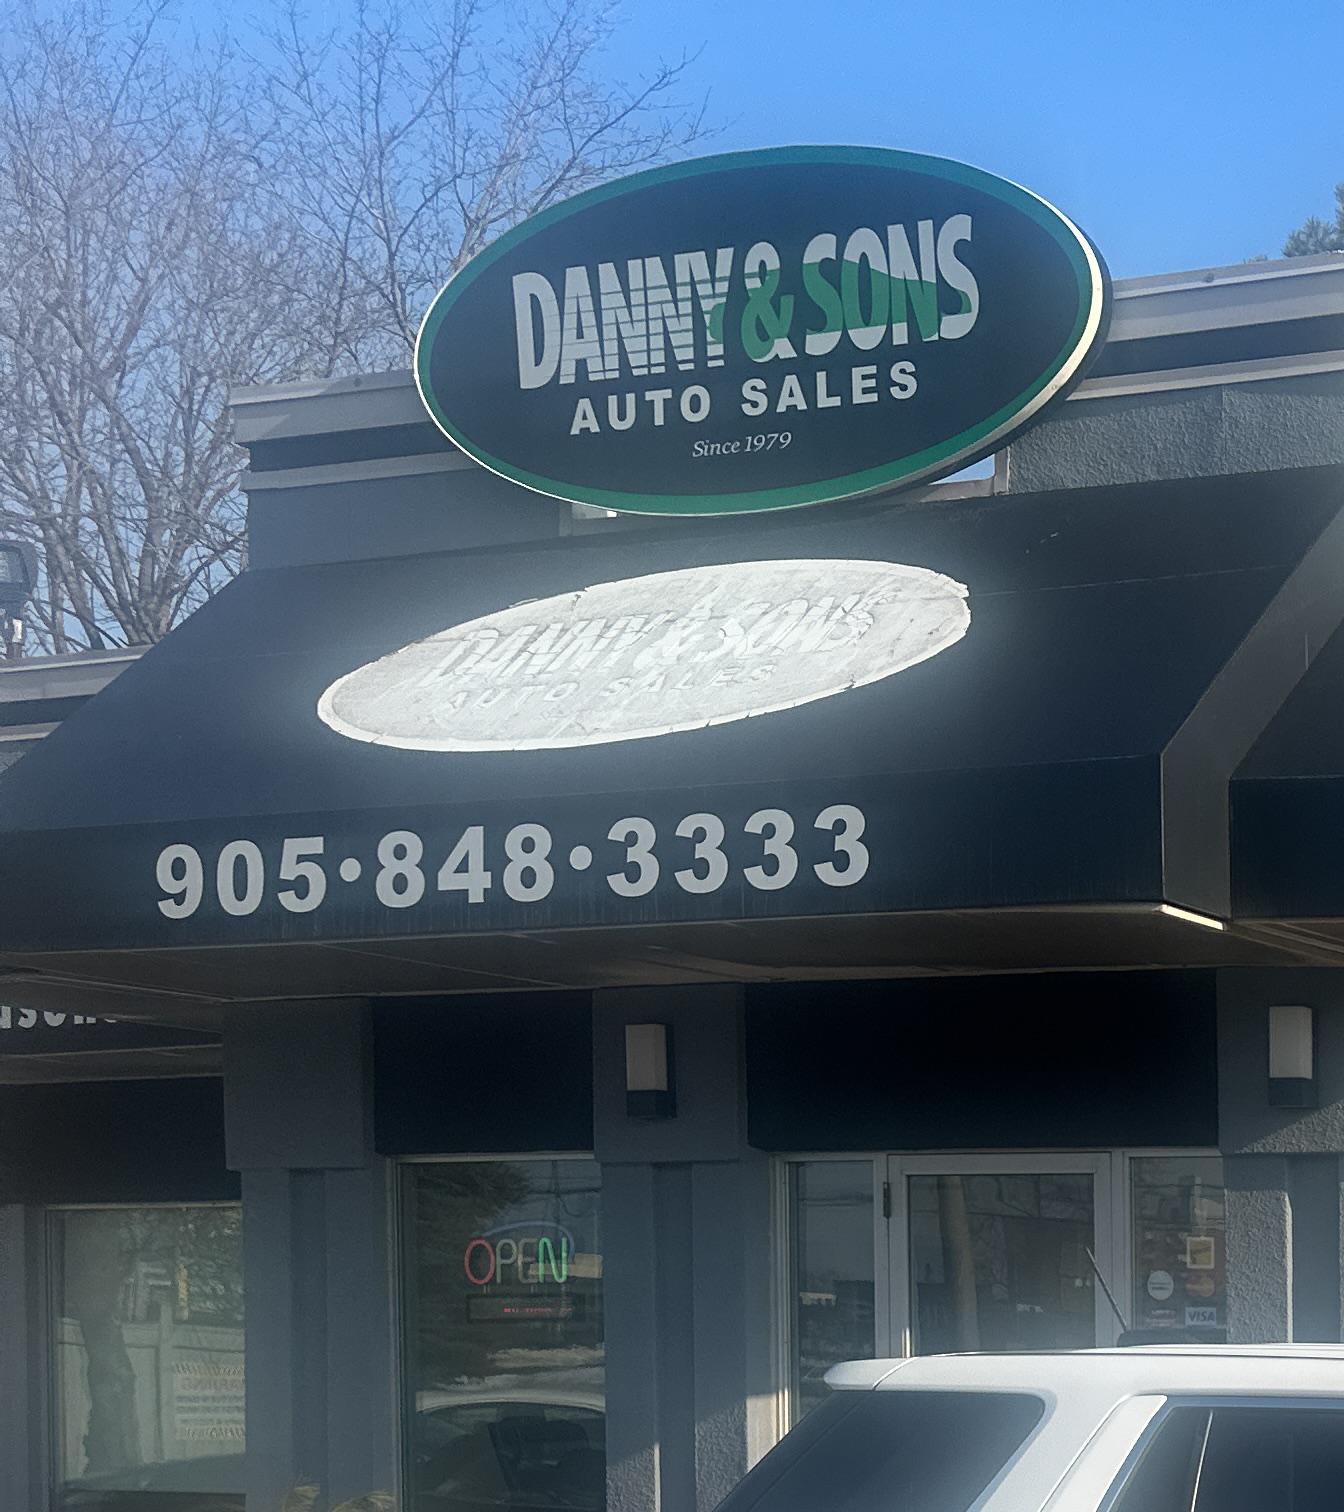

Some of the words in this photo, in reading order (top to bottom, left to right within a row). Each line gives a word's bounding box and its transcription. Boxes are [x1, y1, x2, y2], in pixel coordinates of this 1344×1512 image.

[512, 247, 735, 390] DANNY
[740, 241, 794, 363] &
[802, 214, 980, 357] SONS
[570, 383, 712, 435] AUTO
[740, 360, 918, 417] SALES
[692, 436, 739, 458] Since
[744, 431, 791, 454] 1979
[464, 1237, 568, 1285] OPEN
[1187, 1310, 1215, 1322] VISA
